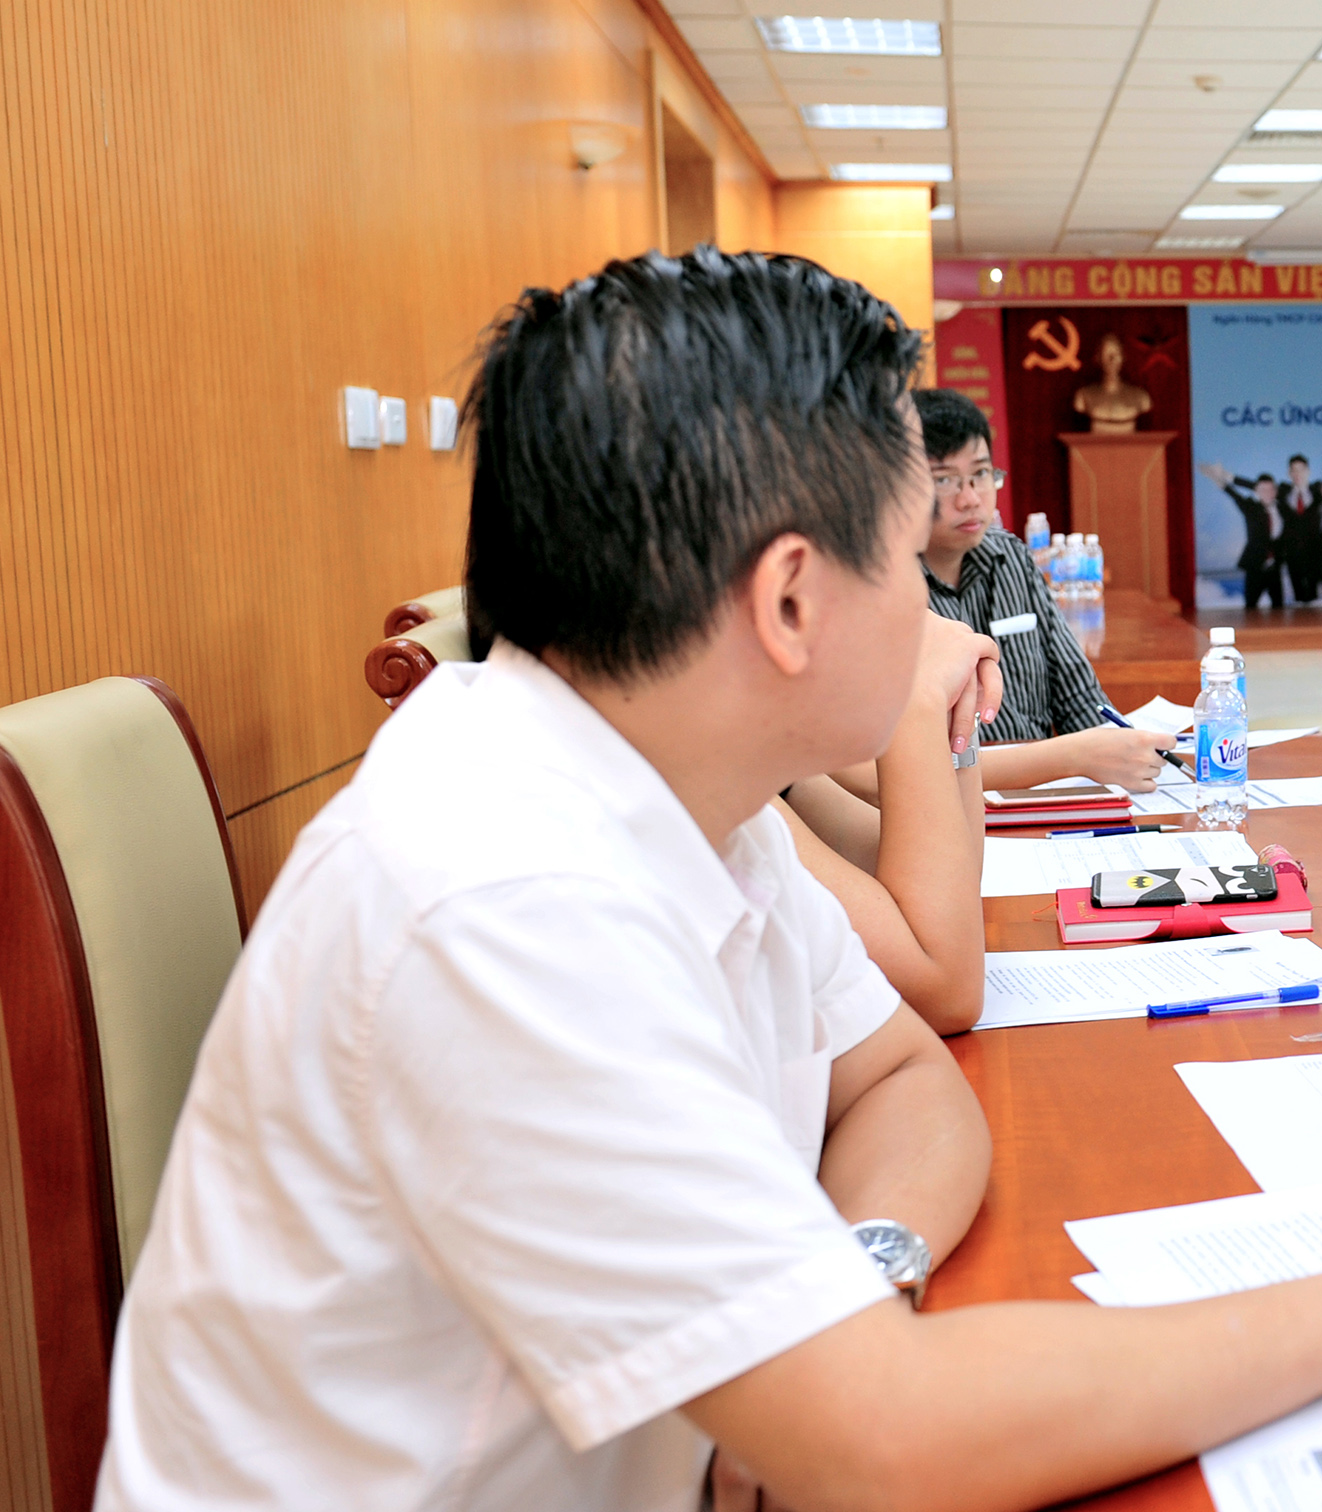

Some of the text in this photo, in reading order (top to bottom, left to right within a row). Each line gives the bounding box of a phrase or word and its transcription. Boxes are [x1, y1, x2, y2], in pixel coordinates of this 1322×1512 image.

[1088, 259, 1183, 299] CỘNG
[1192, 260, 1264, 296] SẢN
[1220, 401, 1273, 427] CÁC
